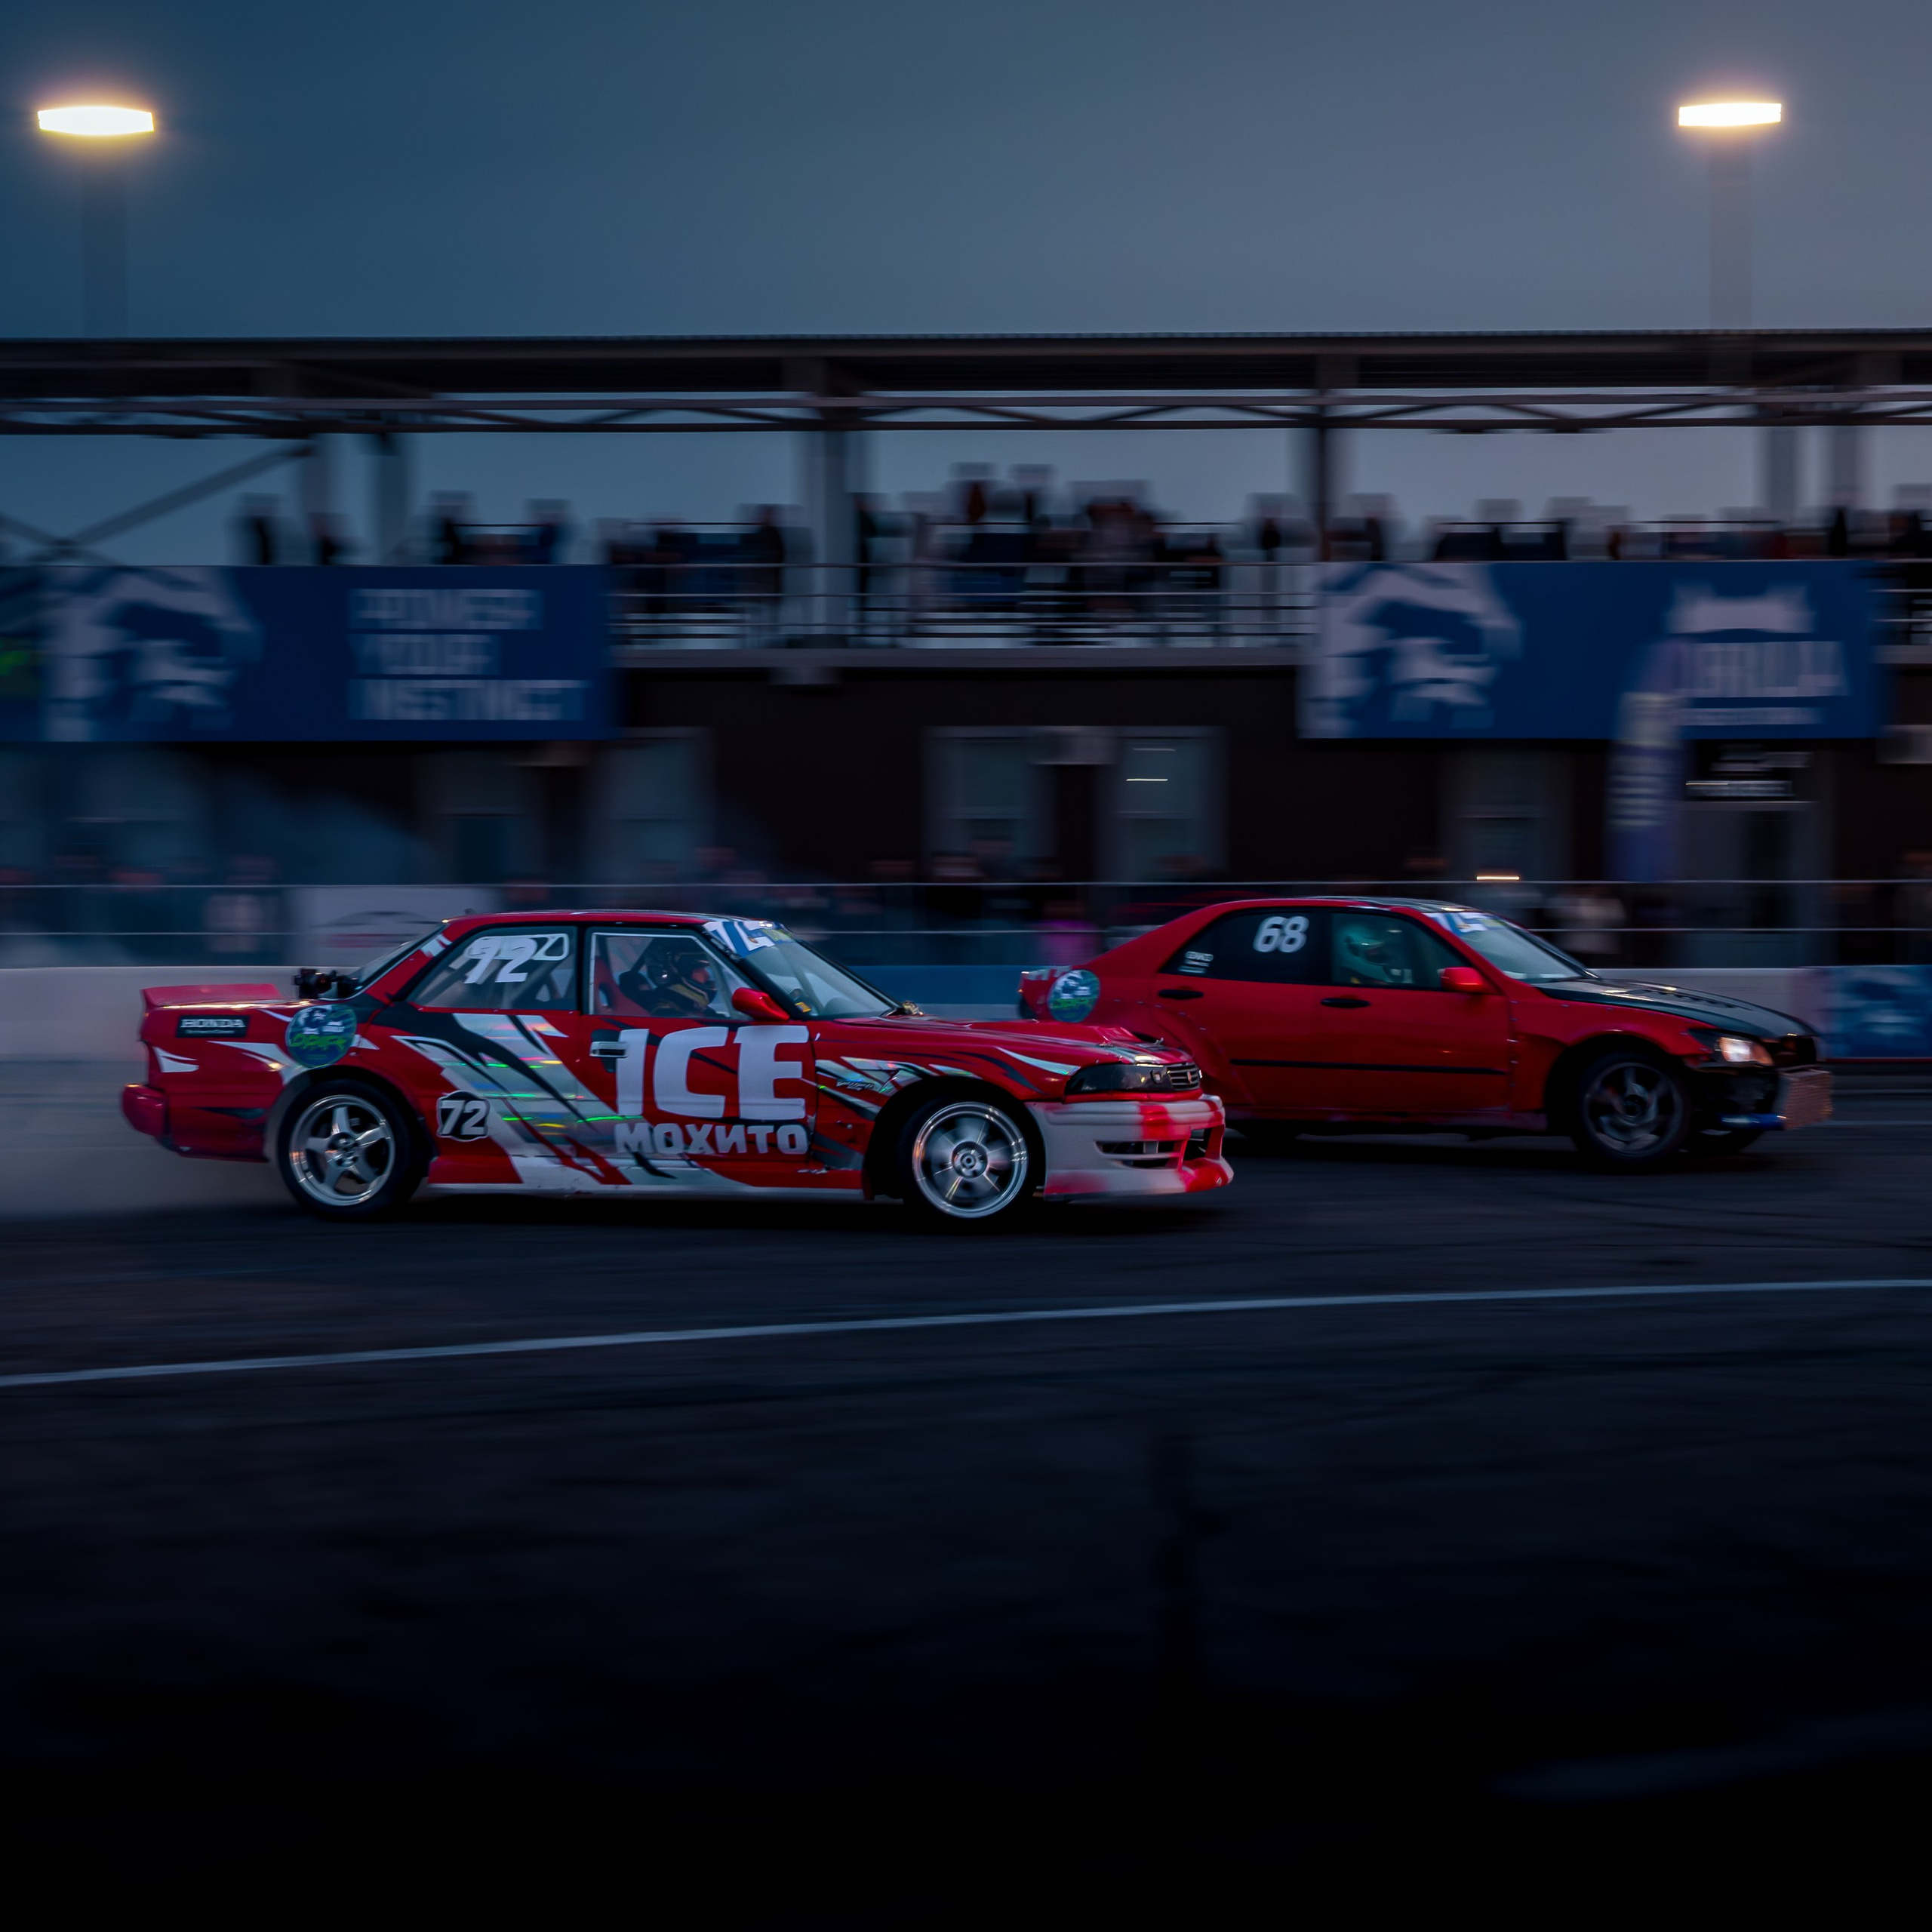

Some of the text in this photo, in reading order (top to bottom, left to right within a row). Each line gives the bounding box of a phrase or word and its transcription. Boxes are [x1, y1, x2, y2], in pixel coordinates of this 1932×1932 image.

[1253, 915, 1310, 952] 68
[615, 1025, 810, 1120] ICE
[438, 1100, 487, 1135] 72
[614, 1122, 811, 1155] МОХИТО
